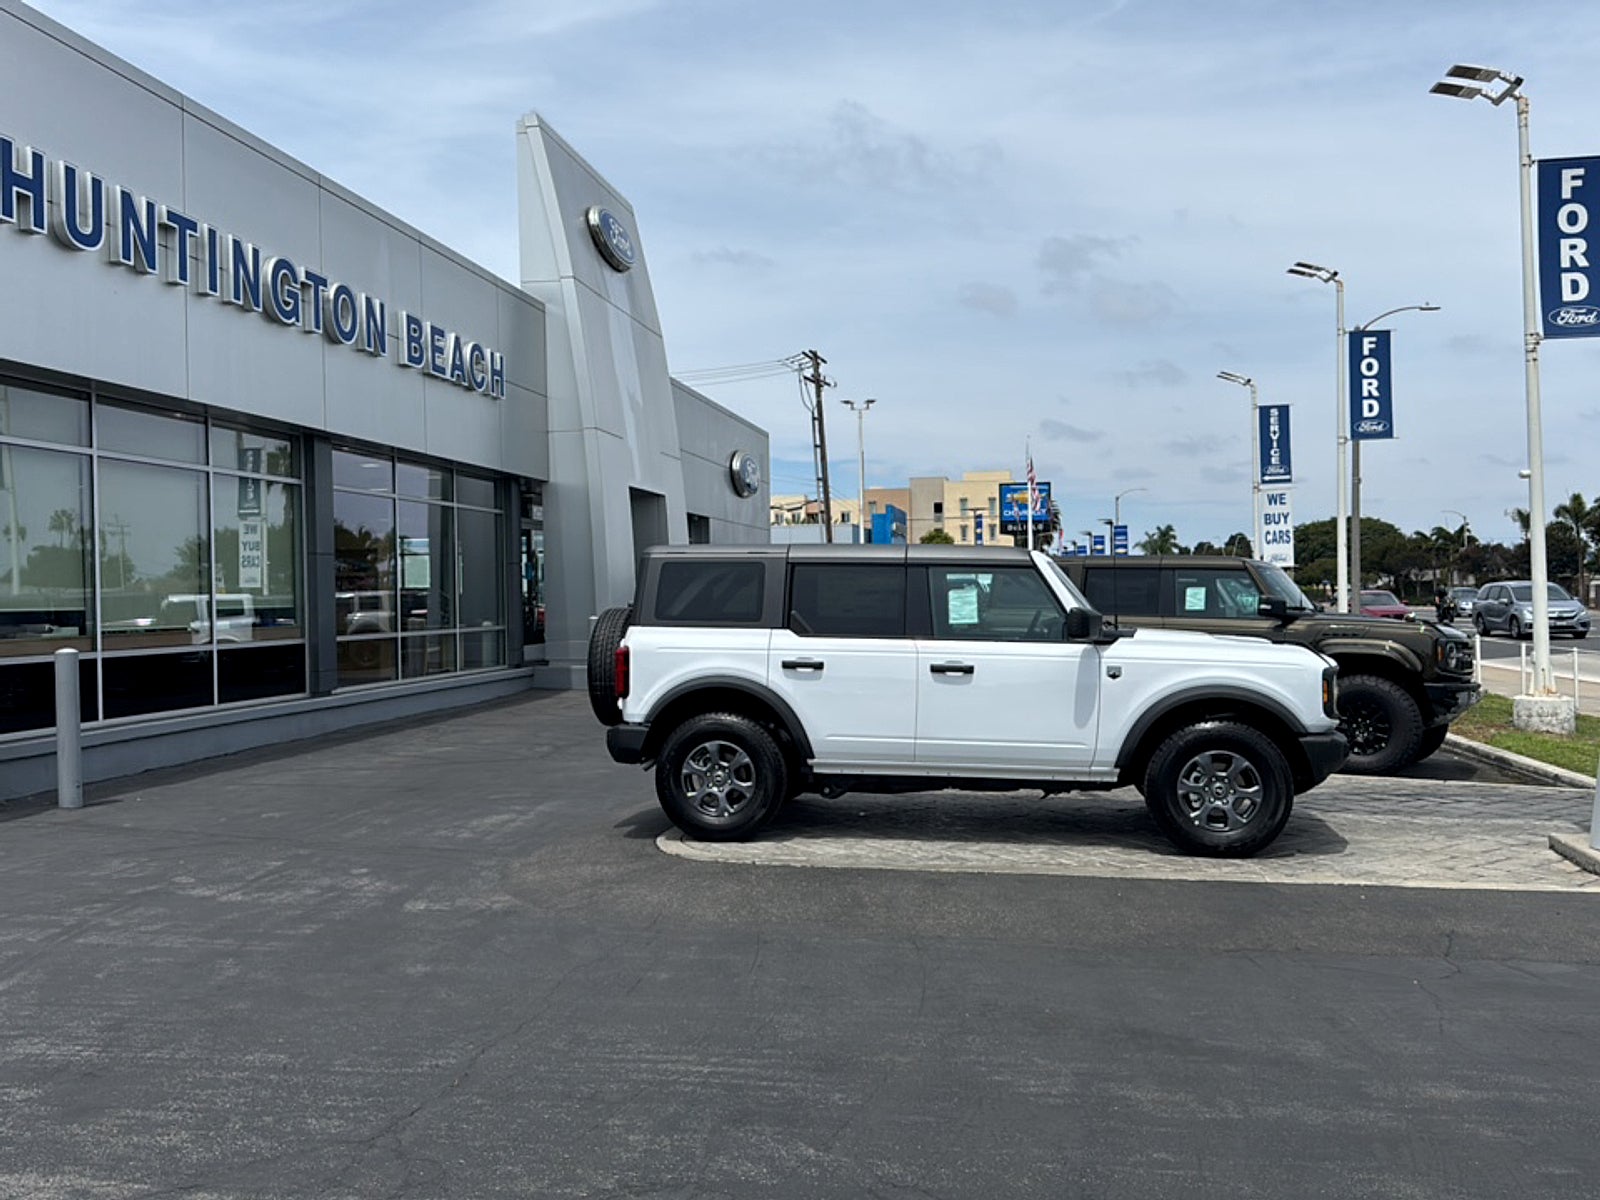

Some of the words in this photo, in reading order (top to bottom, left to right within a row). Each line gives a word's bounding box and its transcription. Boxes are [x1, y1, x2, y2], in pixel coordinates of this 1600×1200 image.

[1557, 168, 1590, 302] FORD
[0, 135, 387, 357] HUNTINGTON
[400, 310, 505, 400] BEACH
[1556, 308, 1598, 325] Ford
[1360, 336, 1380, 418] FORD
[1357, 419, 1387, 433] Ford
[1269, 408, 1280, 465] SERVICE
[1267, 493, 1287, 506] WE
[1264, 512, 1290, 525] BUY
[1265, 530, 1291, 545] CARS
